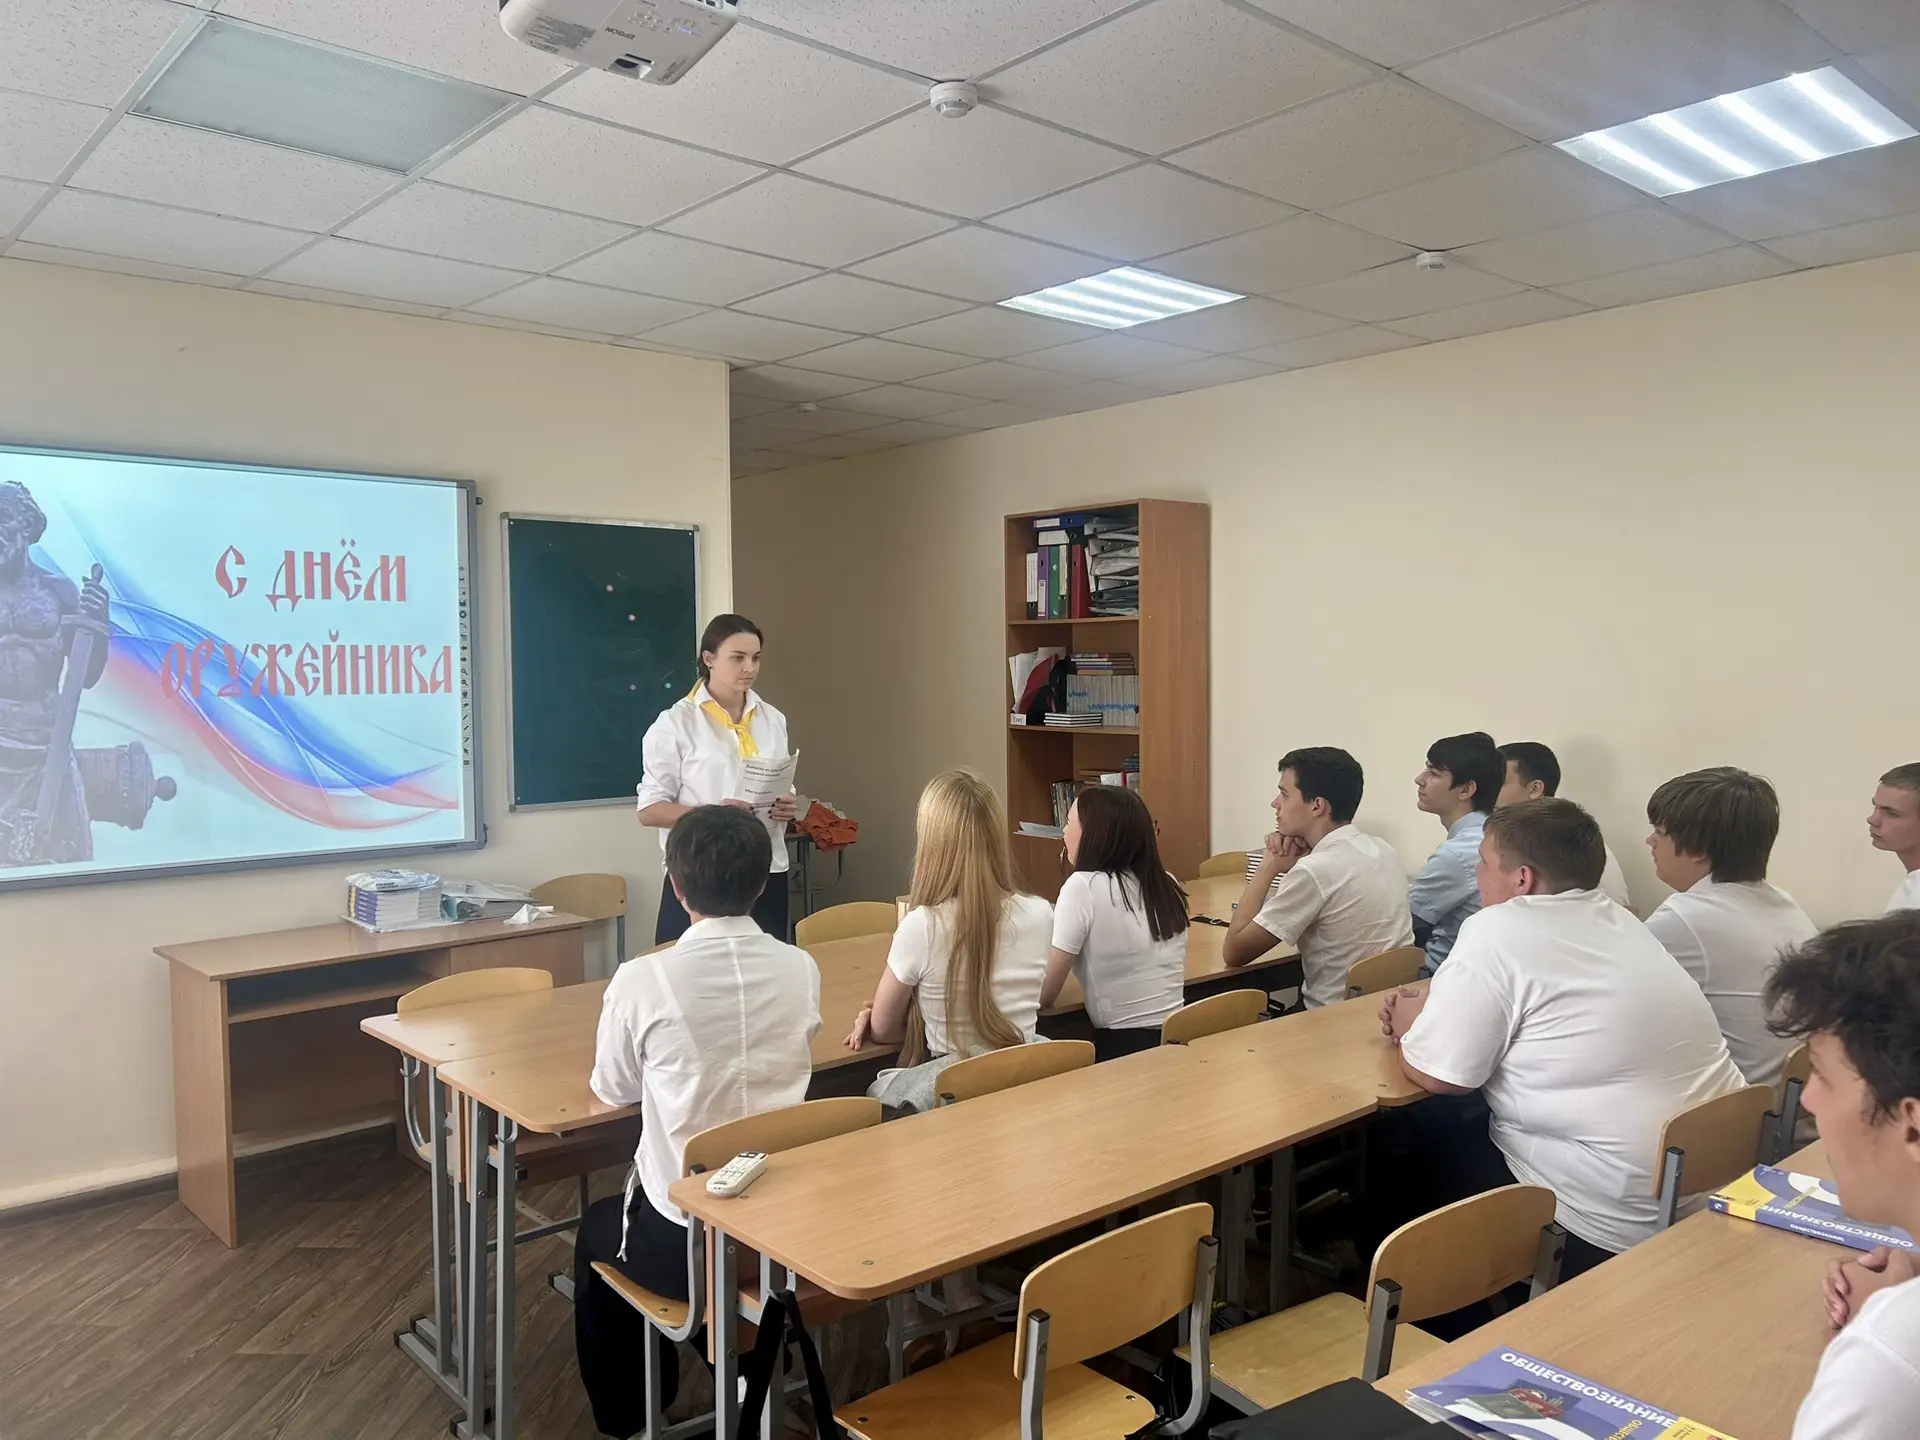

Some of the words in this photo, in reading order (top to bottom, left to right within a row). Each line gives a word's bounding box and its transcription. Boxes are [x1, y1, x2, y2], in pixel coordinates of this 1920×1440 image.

[215, 544, 247, 599] С
[265, 538, 407, 612] ДНЁМ
[161, 628, 453, 699] ОРУЖЕЙНИКА
[1762, 1204, 1914, 1248] ОБЩЕСТВОЗНАНИЕ
[1499, 1352, 1678, 1428] ОБЩЕСТВОЗНАНИЕ
